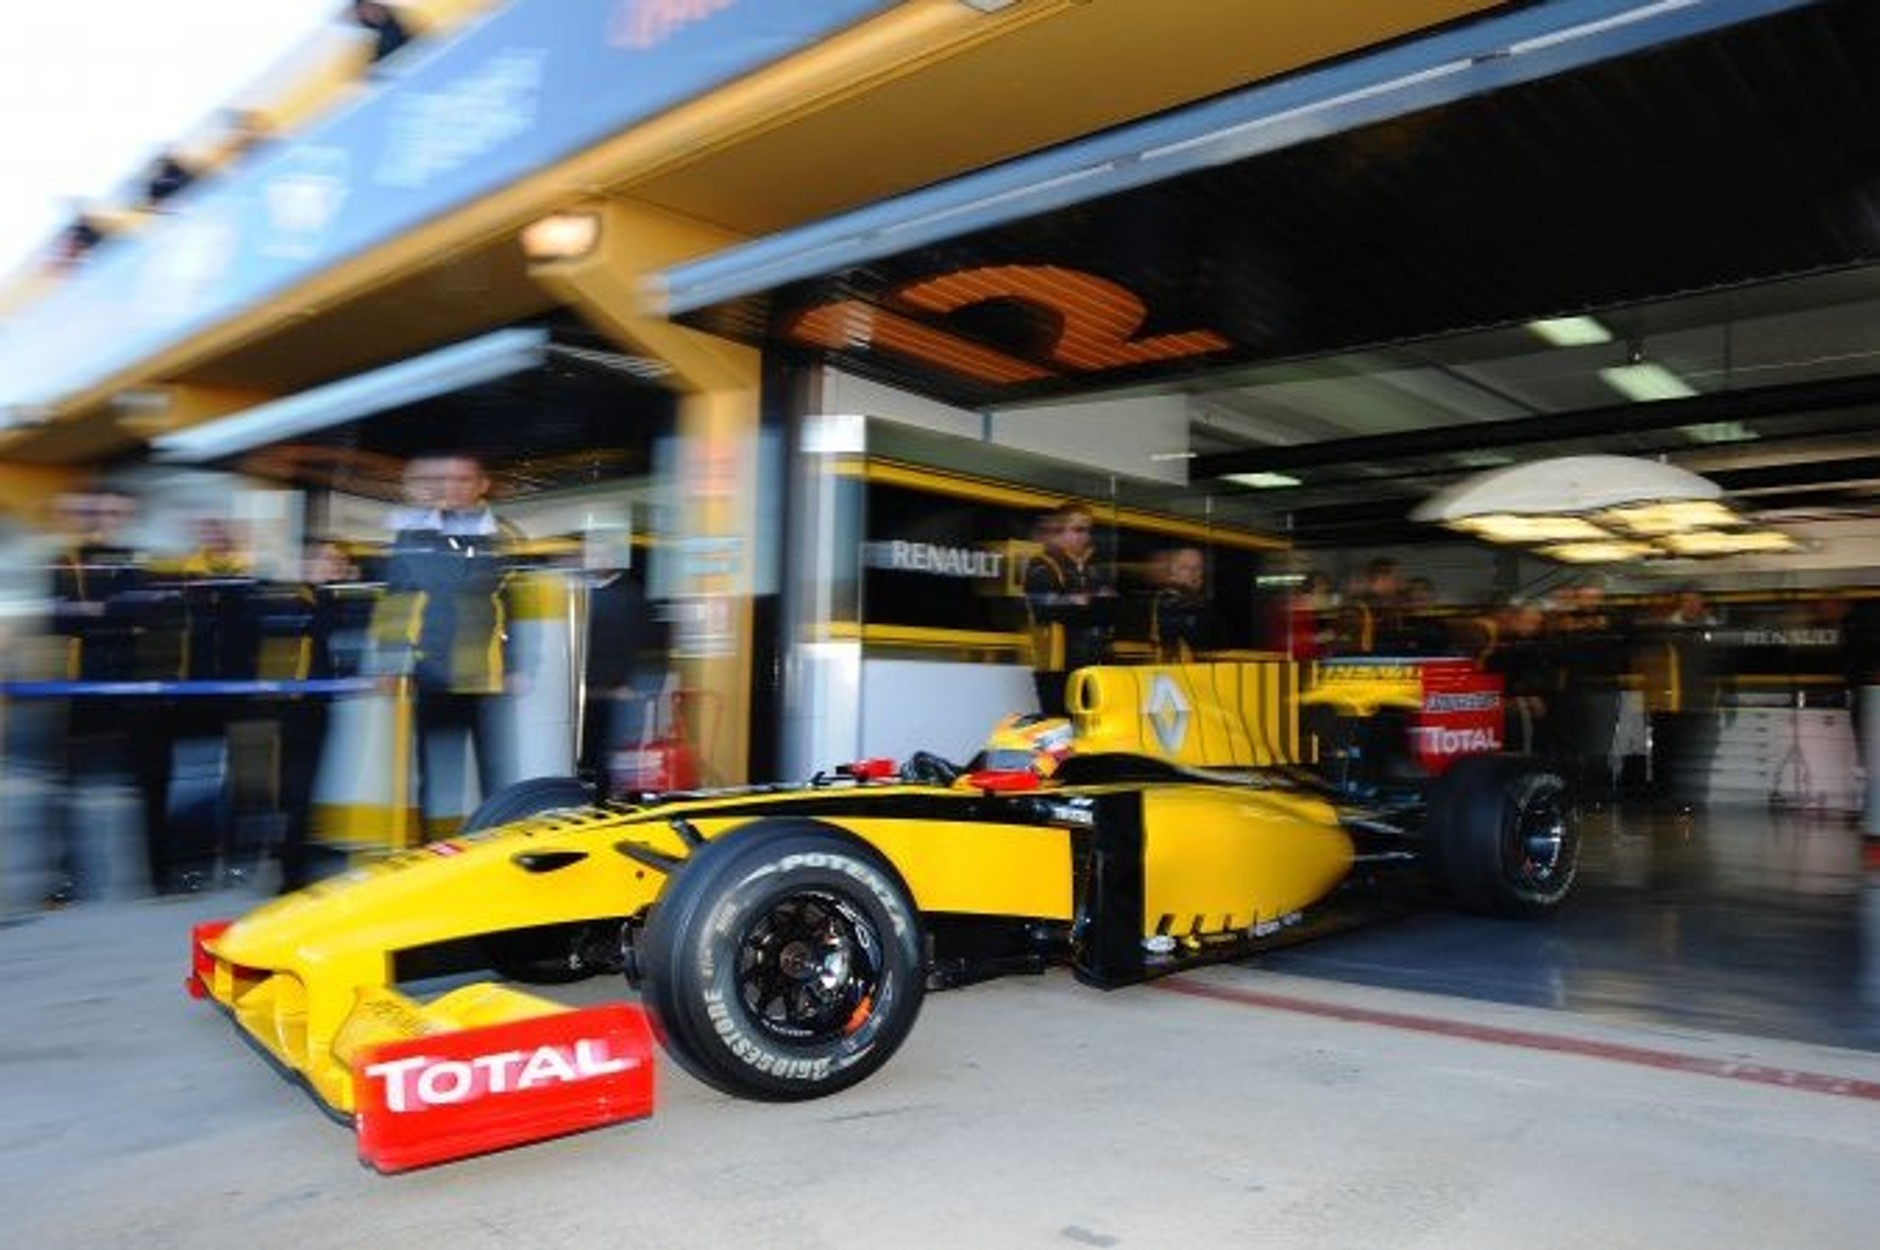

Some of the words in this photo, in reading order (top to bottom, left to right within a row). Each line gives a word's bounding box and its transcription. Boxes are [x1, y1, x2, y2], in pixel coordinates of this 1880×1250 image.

[890, 540, 1003, 577] RENAULT
[1422, 727, 1502, 754] TOTAL
[780, 852, 906, 936] POTENZA
[703, 988, 831, 1080] BRIDGESTONE
[366, 1039, 641, 1112] TOTAL
